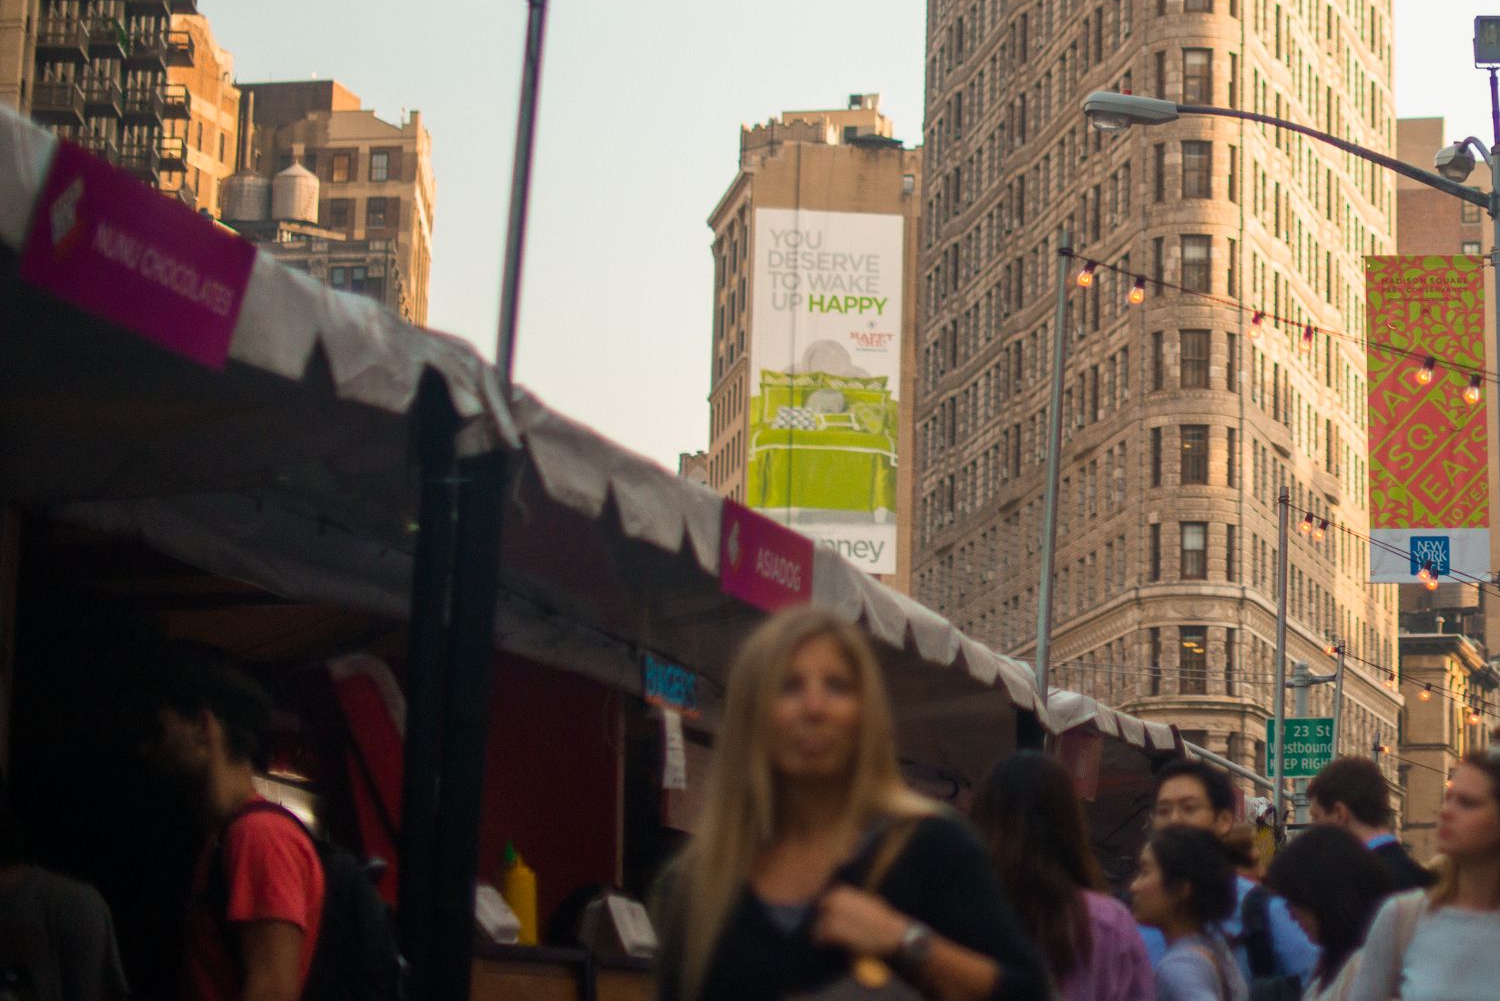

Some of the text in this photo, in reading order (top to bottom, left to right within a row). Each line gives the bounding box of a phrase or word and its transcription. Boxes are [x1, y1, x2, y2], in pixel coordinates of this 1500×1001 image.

[769, 229, 823, 249] YOU
[767, 250, 880, 273] DESERVE
[767, 270, 880, 294] TO WAKE
[771, 292, 888, 316] UP HAPPY
[1446, 507, 1464, 525] 10
[1418, 540, 1445, 552] NEW
[1413, 550, 1447, 564] YORK
[1293, 725, 1309, 737] 23
[1316, 725, 1331, 737] St
[1270, 758, 1330, 770] EP RIGH
